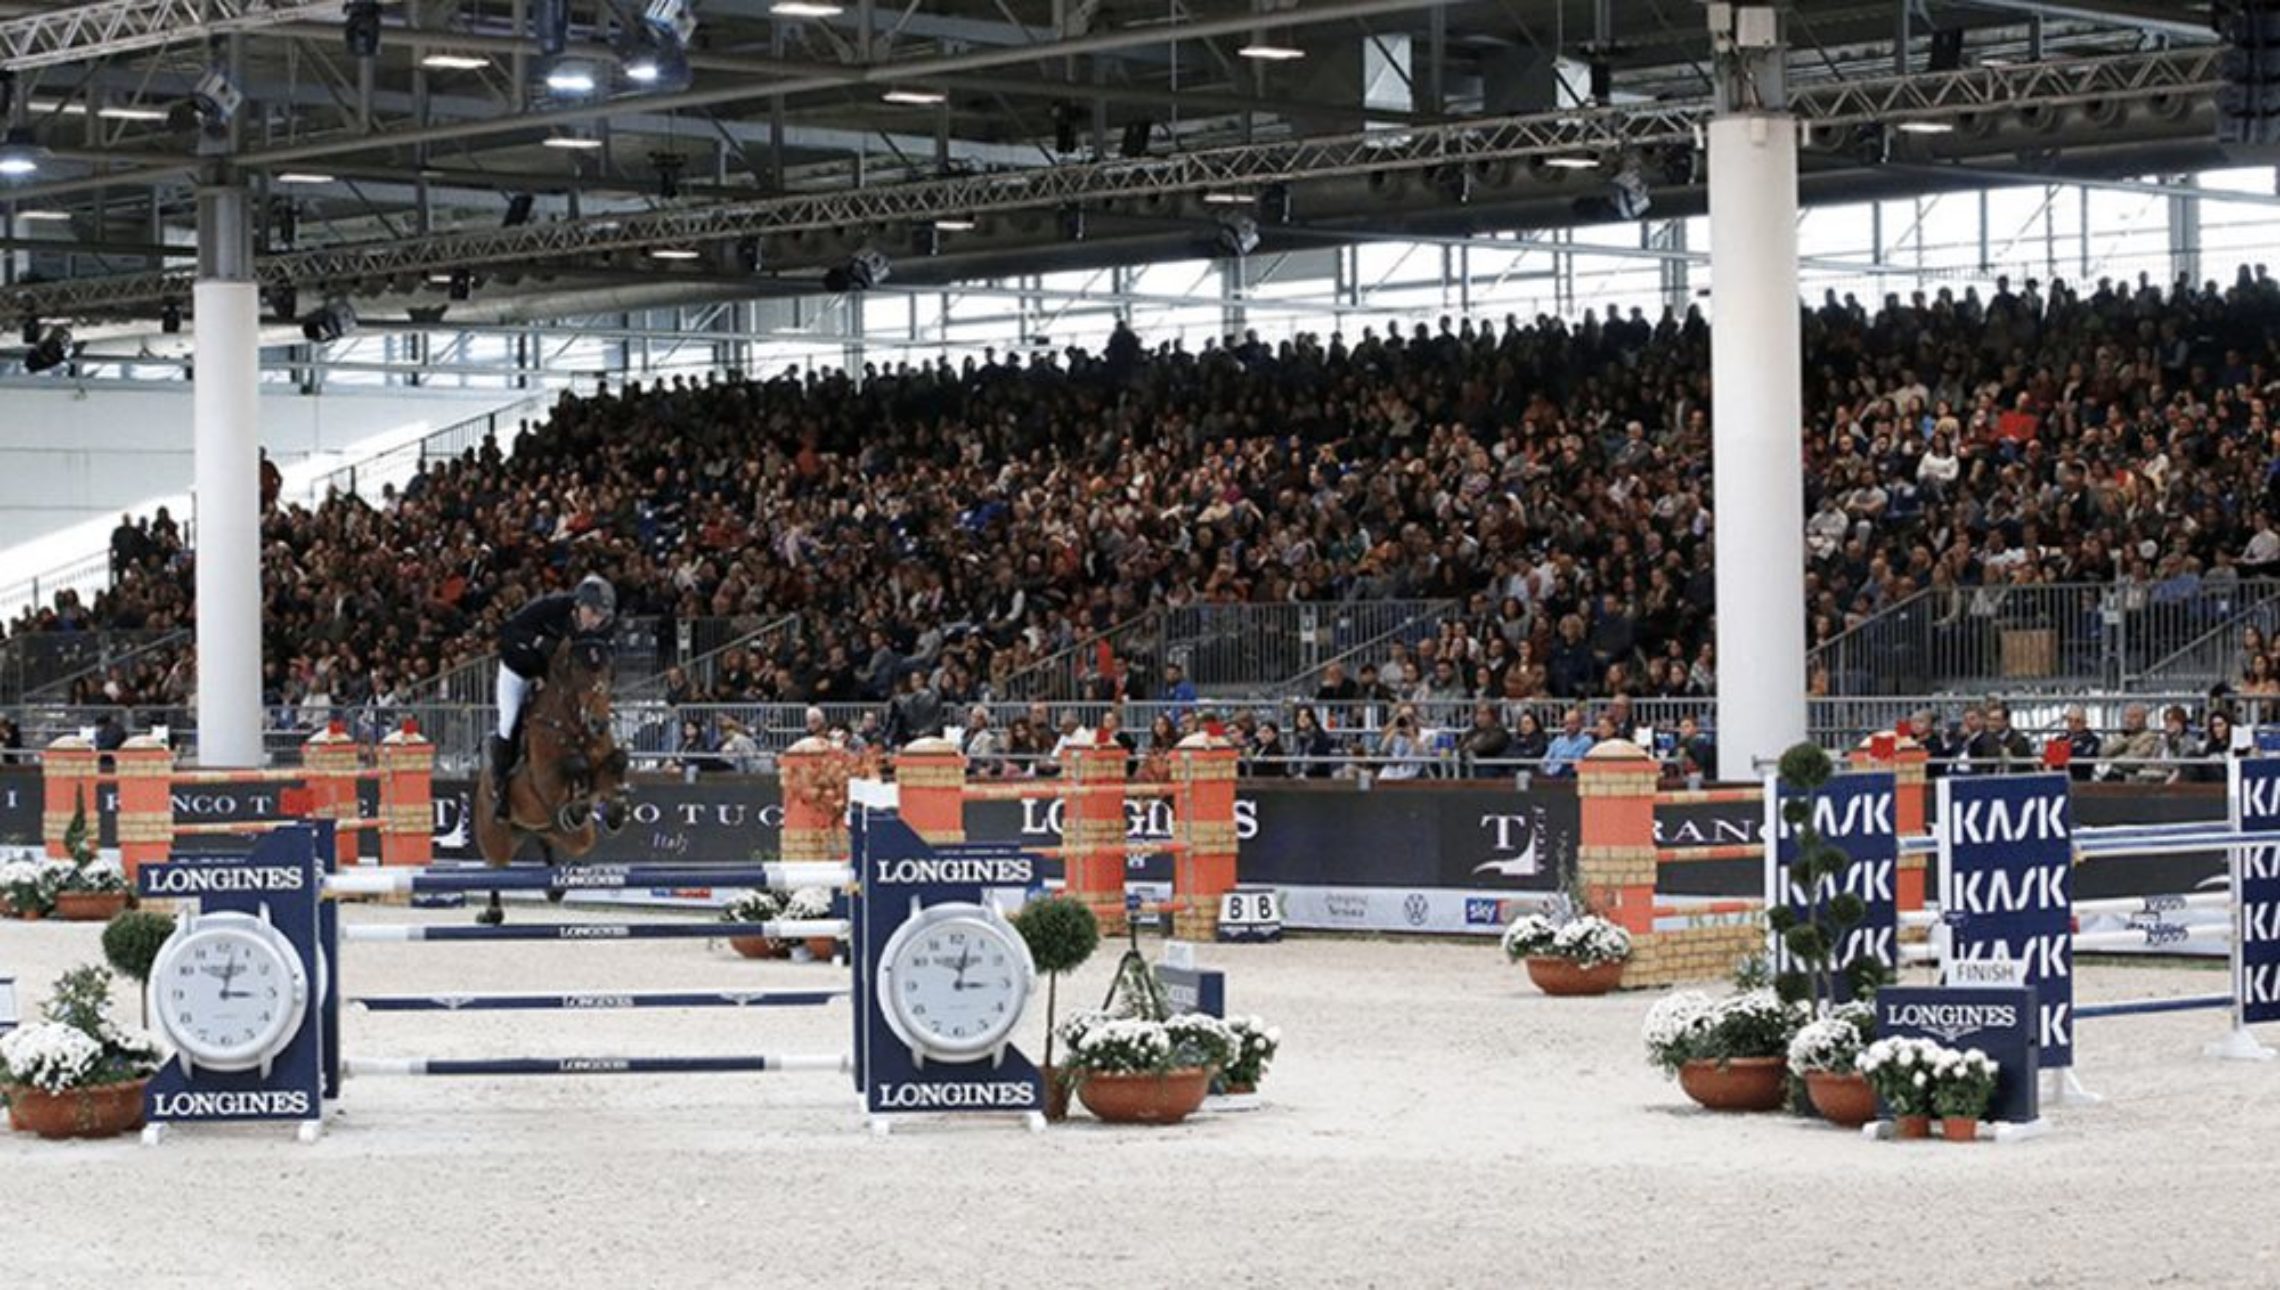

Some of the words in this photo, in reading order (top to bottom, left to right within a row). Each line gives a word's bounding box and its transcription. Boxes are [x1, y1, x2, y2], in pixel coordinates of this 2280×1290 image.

[1952, 795, 2067, 845] KASK
[148, 866, 303, 892] LONGINES
[877, 858, 1033, 883] LONGINES
[1954, 865, 2067, 914] KASK
[1957, 964, 2014, 981] FINISH
[1887, 1004, 2017, 1028] LONGINES
[154, 1090, 310, 1116] LONGINES
[879, 1081, 1036, 1107] LONGINES
